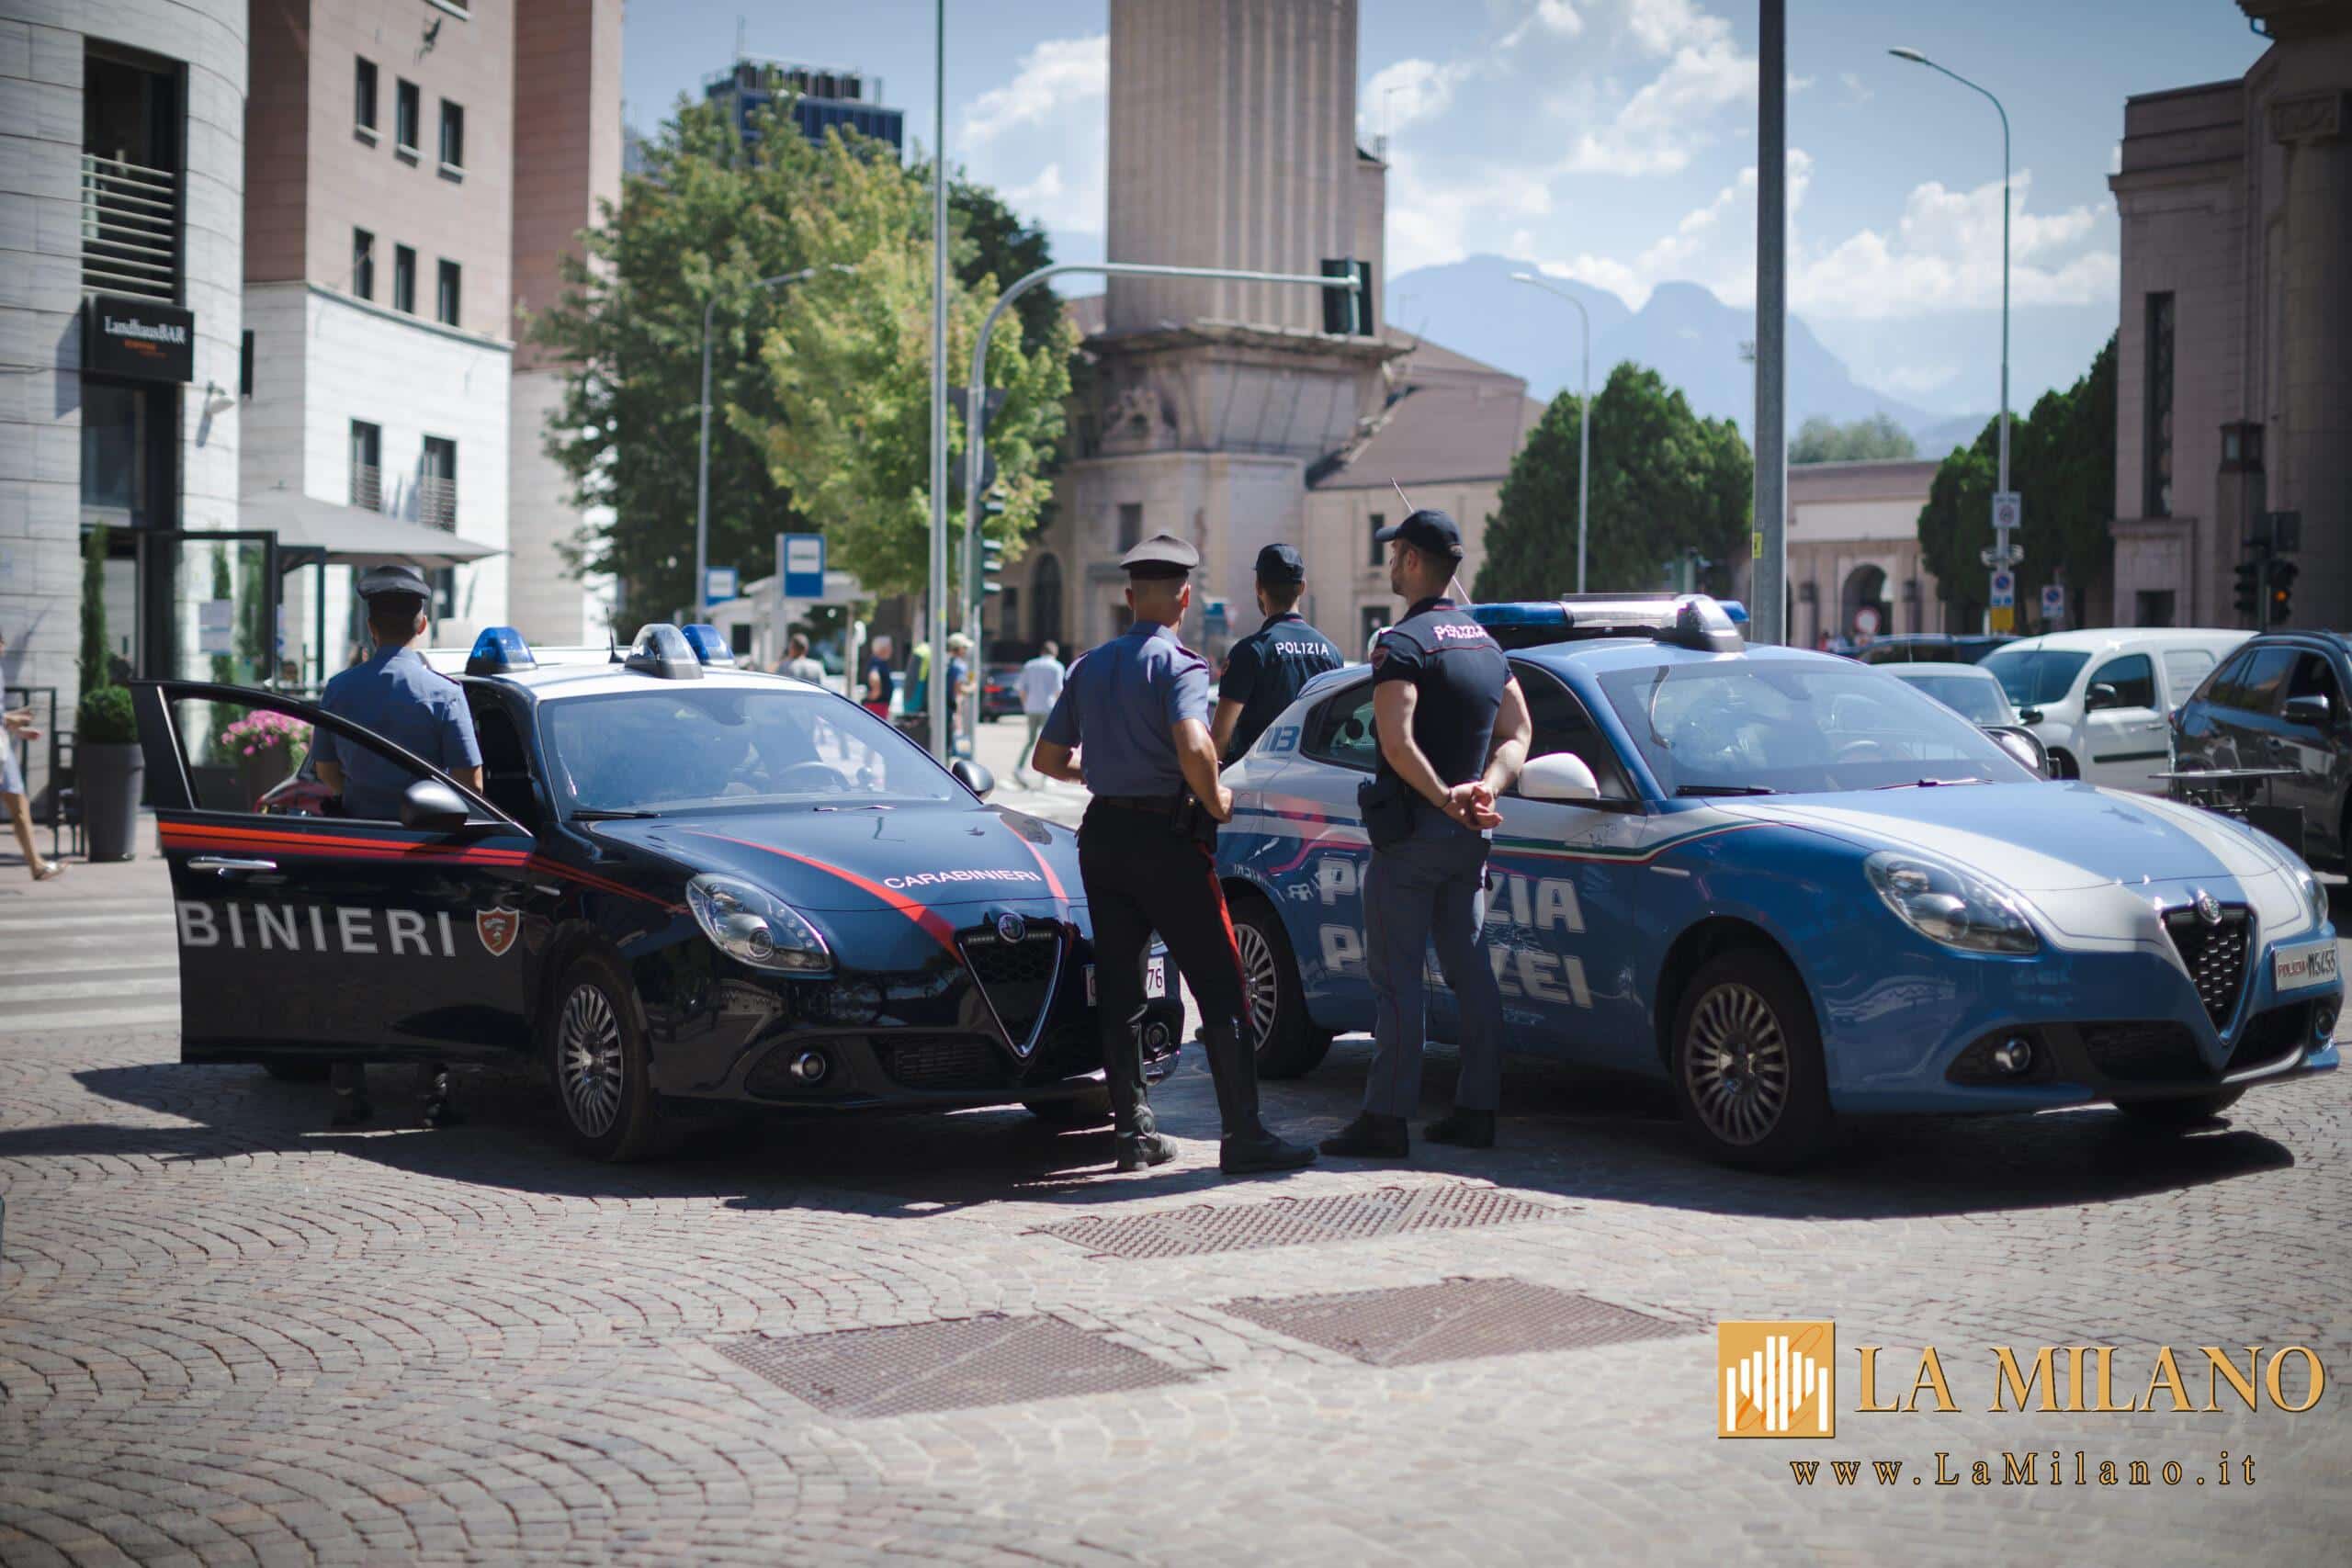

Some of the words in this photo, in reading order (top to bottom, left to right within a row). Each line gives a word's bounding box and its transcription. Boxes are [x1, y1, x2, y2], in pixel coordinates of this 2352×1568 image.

[1274, 641, 1330, 656] POLIZIA
[884, 869, 1043, 889] CARABINIERI
[176, 899, 457, 957] BINIERI
